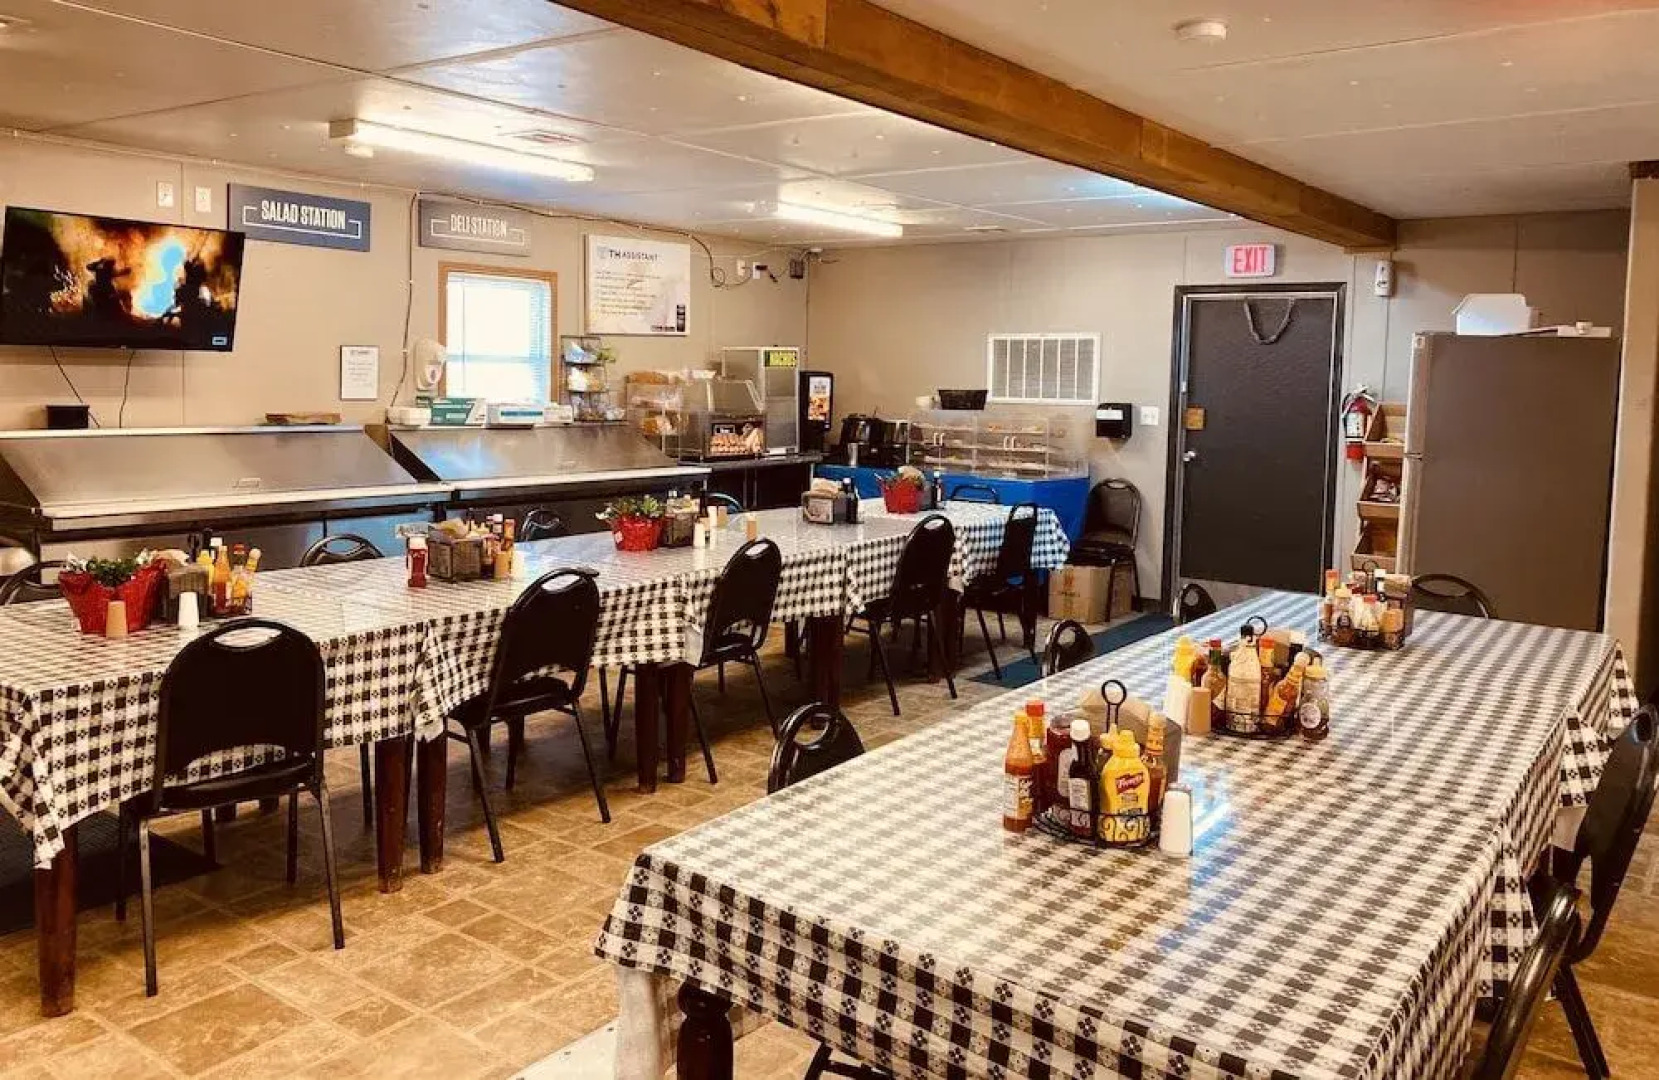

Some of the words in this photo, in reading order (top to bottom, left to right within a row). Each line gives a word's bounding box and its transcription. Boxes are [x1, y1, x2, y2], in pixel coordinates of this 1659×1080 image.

[261, 200, 298, 223] SALAD
[300, 205, 346, 230] STATION
[450, 213, 470, 233] DELI
[471, 216, 507, 238] STATION
[1233, 246, 1267, 273] EXIT
